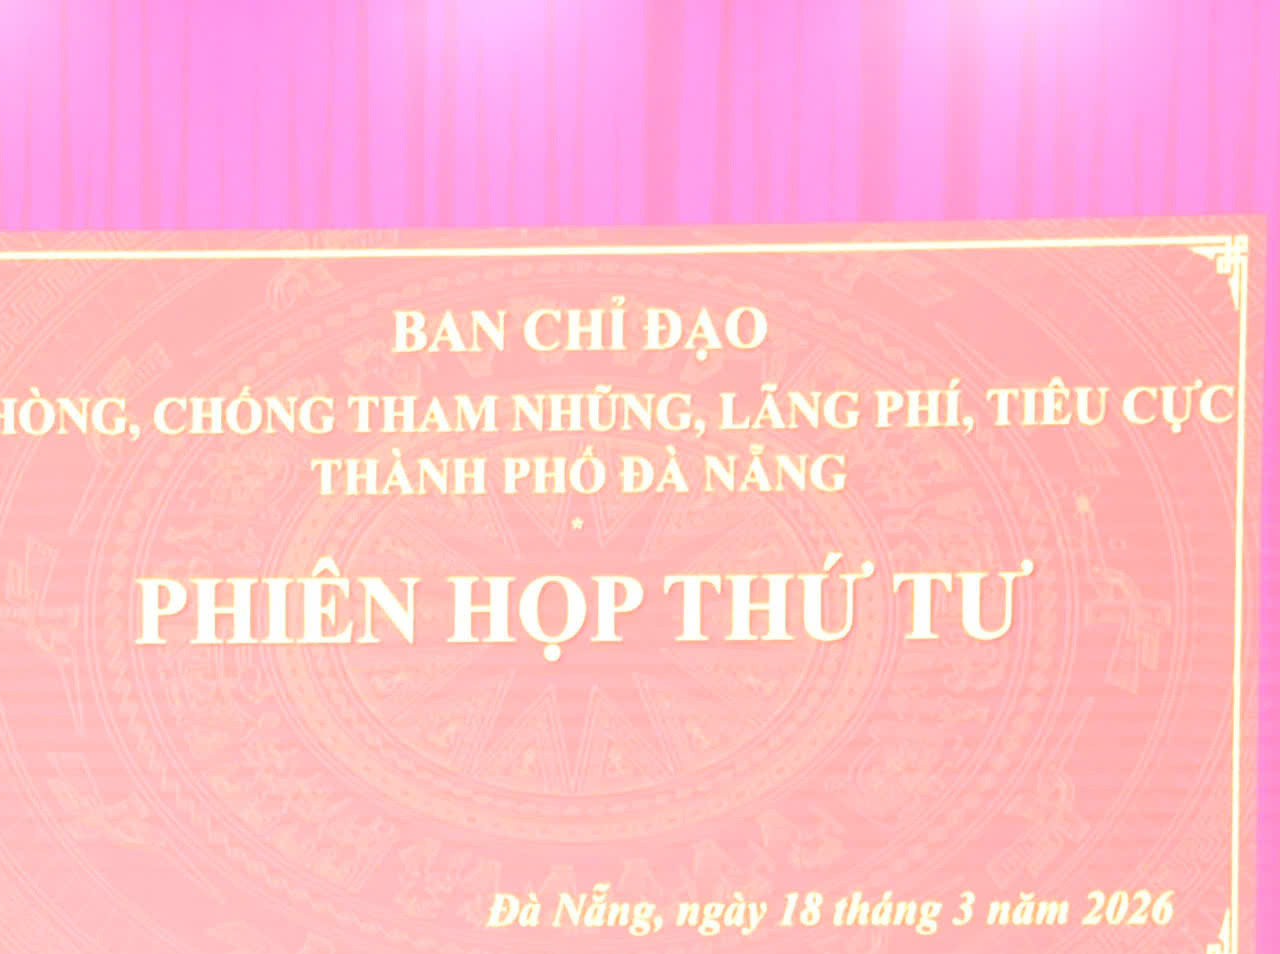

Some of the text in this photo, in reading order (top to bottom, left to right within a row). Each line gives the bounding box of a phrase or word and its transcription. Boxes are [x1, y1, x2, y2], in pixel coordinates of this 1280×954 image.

[392, 296, 769, 360] BAN CHỈ ĐẠO
[153, 385, 335, 434] CHỐNG
[347, 395, 498, 433] THAM
[512, 385, 706, 437] NHŨNG,
[719, 384, 860, 430] LÃNG
[874, 379, 976, 433] PHÍ,
[986, 377, 1110, 426] TIÊU
[1122, 379, 1236, 433] CỰC
[311, 443, 847, 495] THÀNH PHỐ ĐÀ NẴNG
[134, 552, 1034, 662] PHIÊN HỌP THỨ TƯ
[486, 883, 1175, 936] Đà Nẵng, ngày 18 tháng 3 năm 2026
